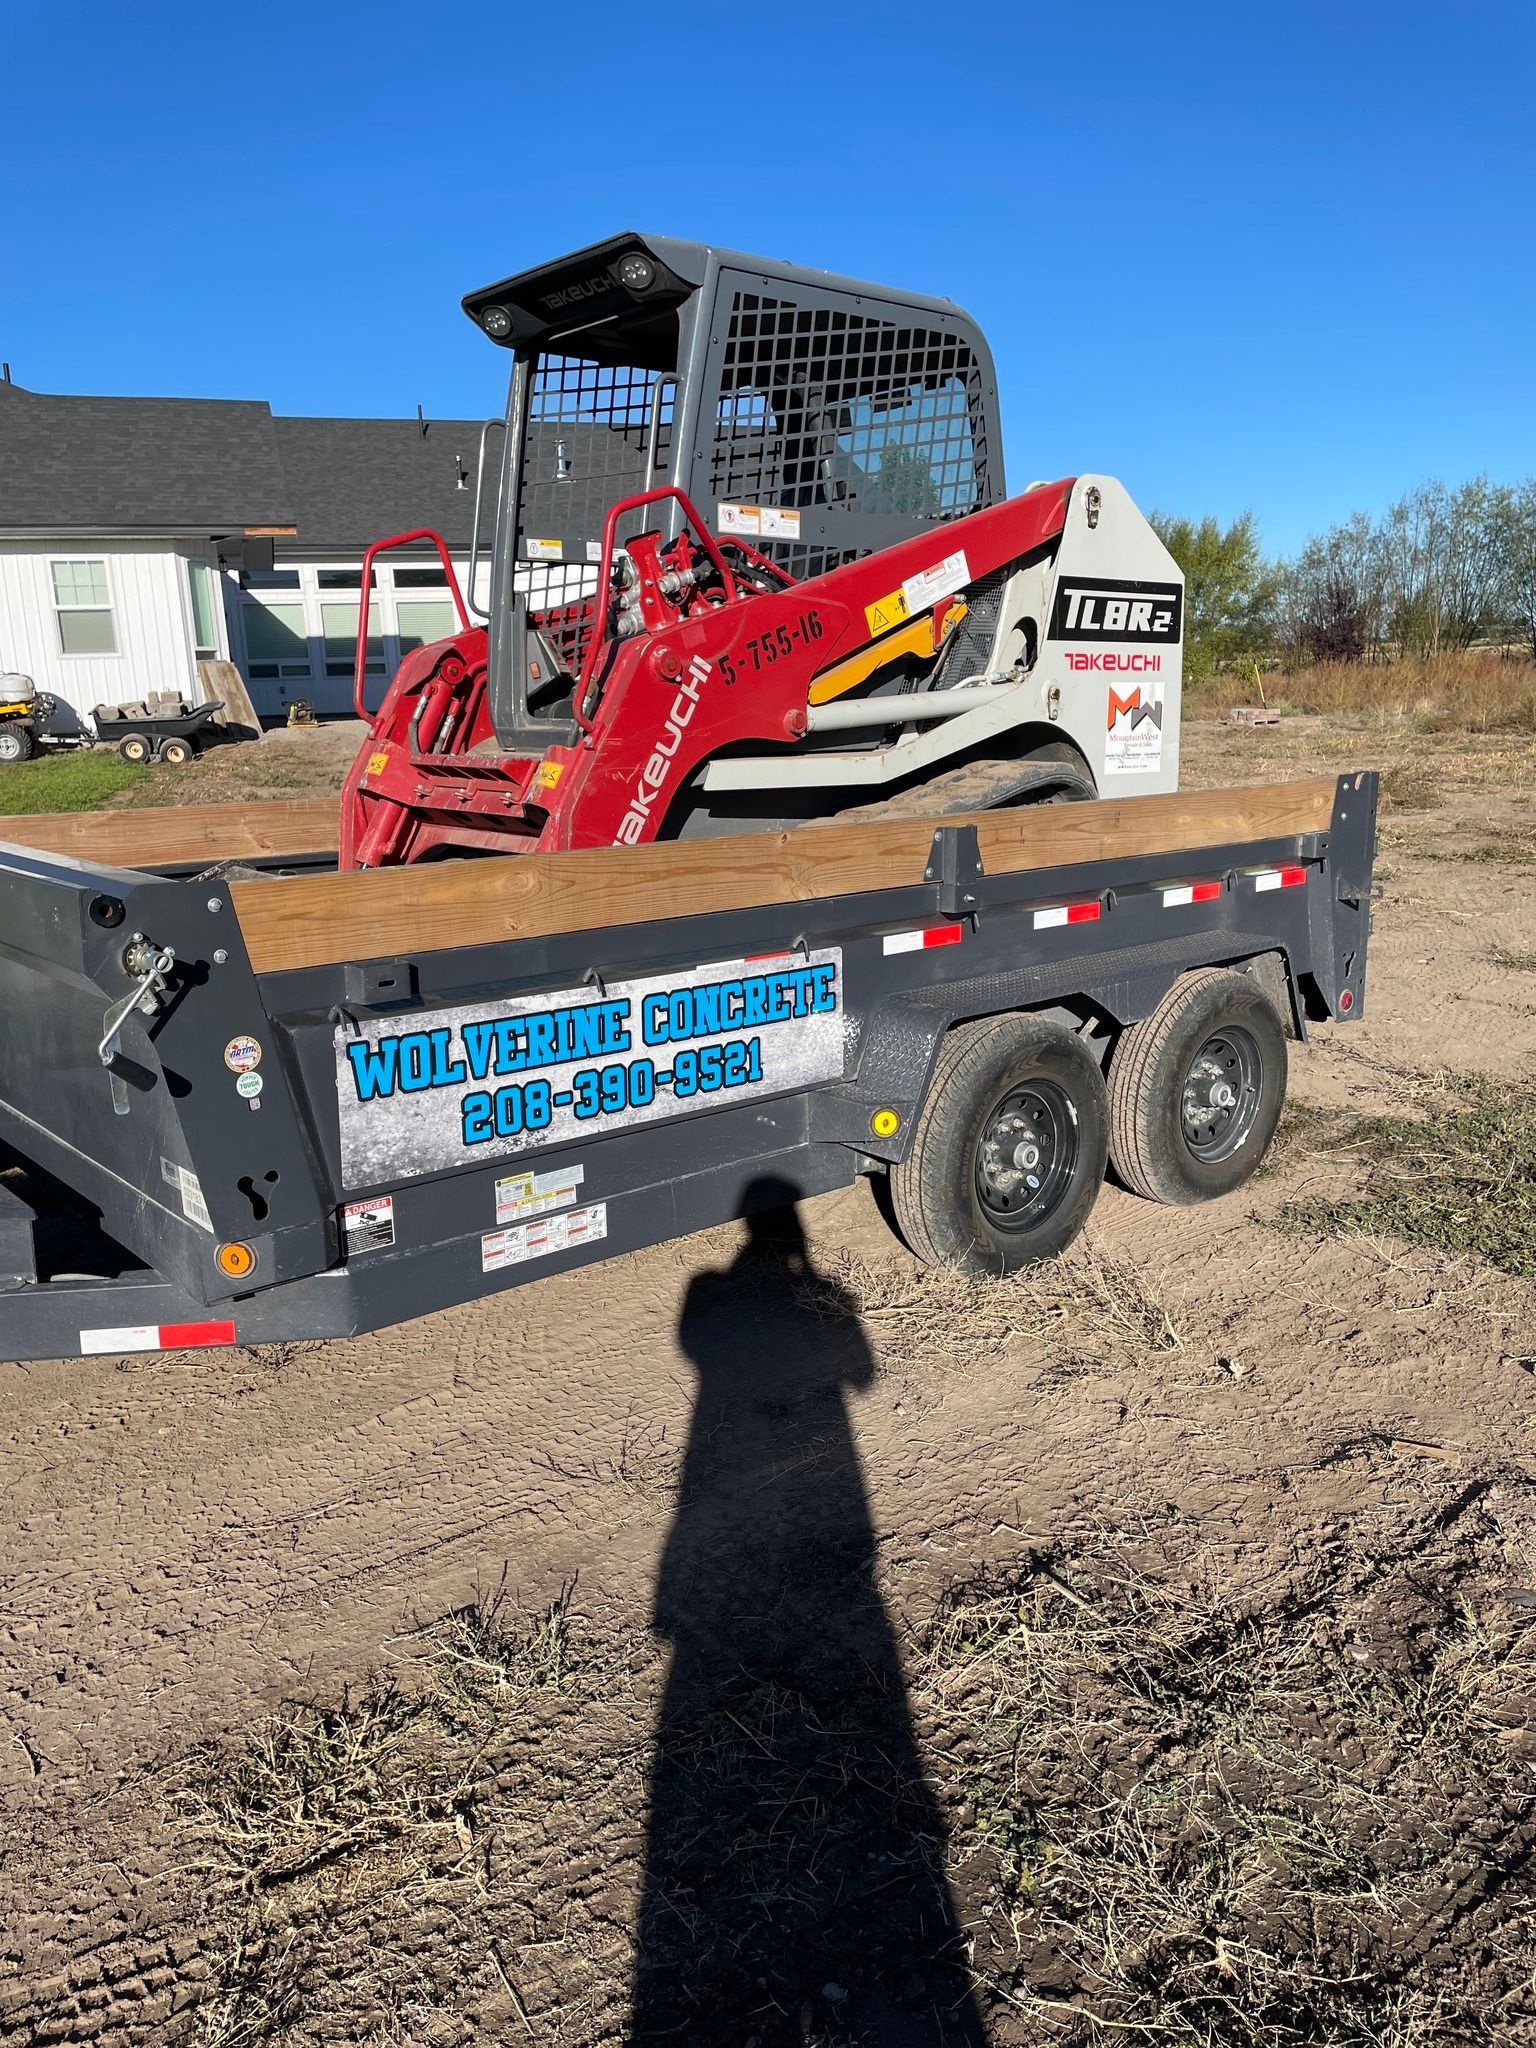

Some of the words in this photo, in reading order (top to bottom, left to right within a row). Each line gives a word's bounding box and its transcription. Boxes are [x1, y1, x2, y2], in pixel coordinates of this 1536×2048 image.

[539, 273, 618, 310] TAKEUCH
[1063, 588, 1177, 633] TL8R2
[717, 610, 824, 686] 5-755-16
[1064, 653, 1161, 672] TAKEUCHI
[612, 654, 713, 847] AKEUCHI
[347, 998, 631, 1102] WOLVERINE
[642, 962, 837, 1048] CONCRETE
[461, 1036, 763, 1147] 208-390-9521
[352, 1200, 388, 1215] DANGER
